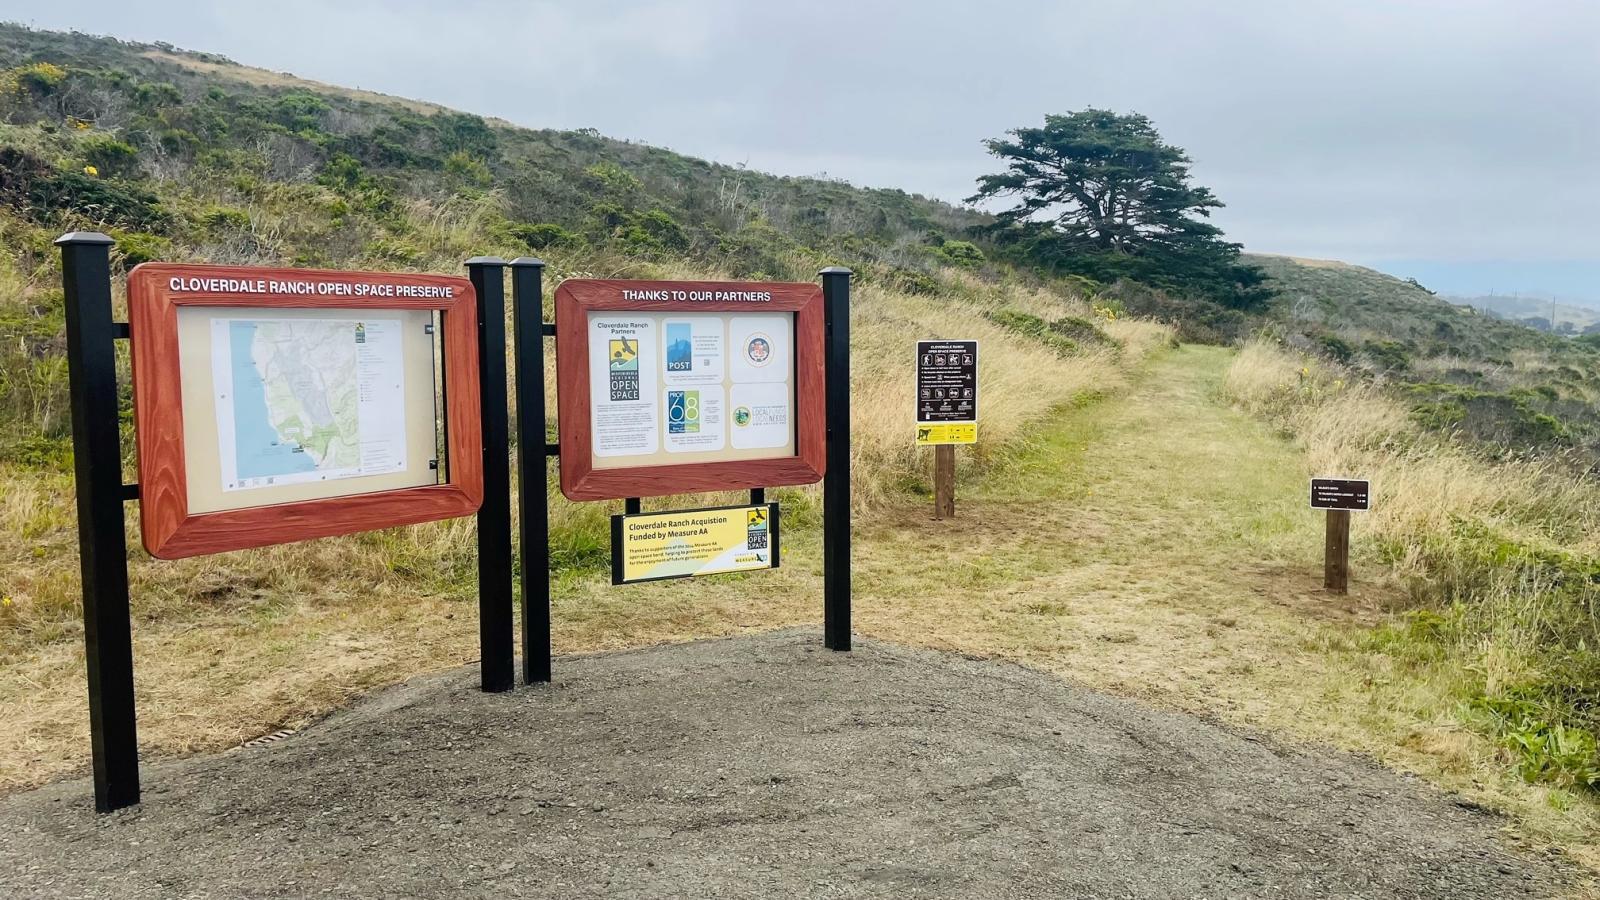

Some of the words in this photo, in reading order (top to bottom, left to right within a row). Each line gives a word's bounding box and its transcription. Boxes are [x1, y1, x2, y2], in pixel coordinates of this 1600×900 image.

[169, 277, 266, 294] CLOVERDALE
[269, 281, 315, 295] RANCH
[317, 283, 351, 296] OPEN
[354, 284, 393, 297] SPACE
[396, 286, 453, 298] PRESERVE
[622, 290, 669, 301] THANKS
[671, 290, 687, 301] TO
[689, 290, 713, 302] OUR
[715, 291, 771, 302] PARTNERS
[669, 361, 690, 370] POST
[611, 380, 638, 390] OPEN
[611, 390, 639, 400] SPACE
[670, 396, 699, 421] 68
[629, 521, 667, 531] Cloverdale
[668, 518, 690, 527] Ranch
[691, 516, 728, 526] Acquistion
[629, 532, 657, 541] Funded
[657, 531, 667, 540] by
[667, 529, 698, 538] Measure
[748, 535, 767, 543] OPEN
[748, 541, 767, 549] SPACE
